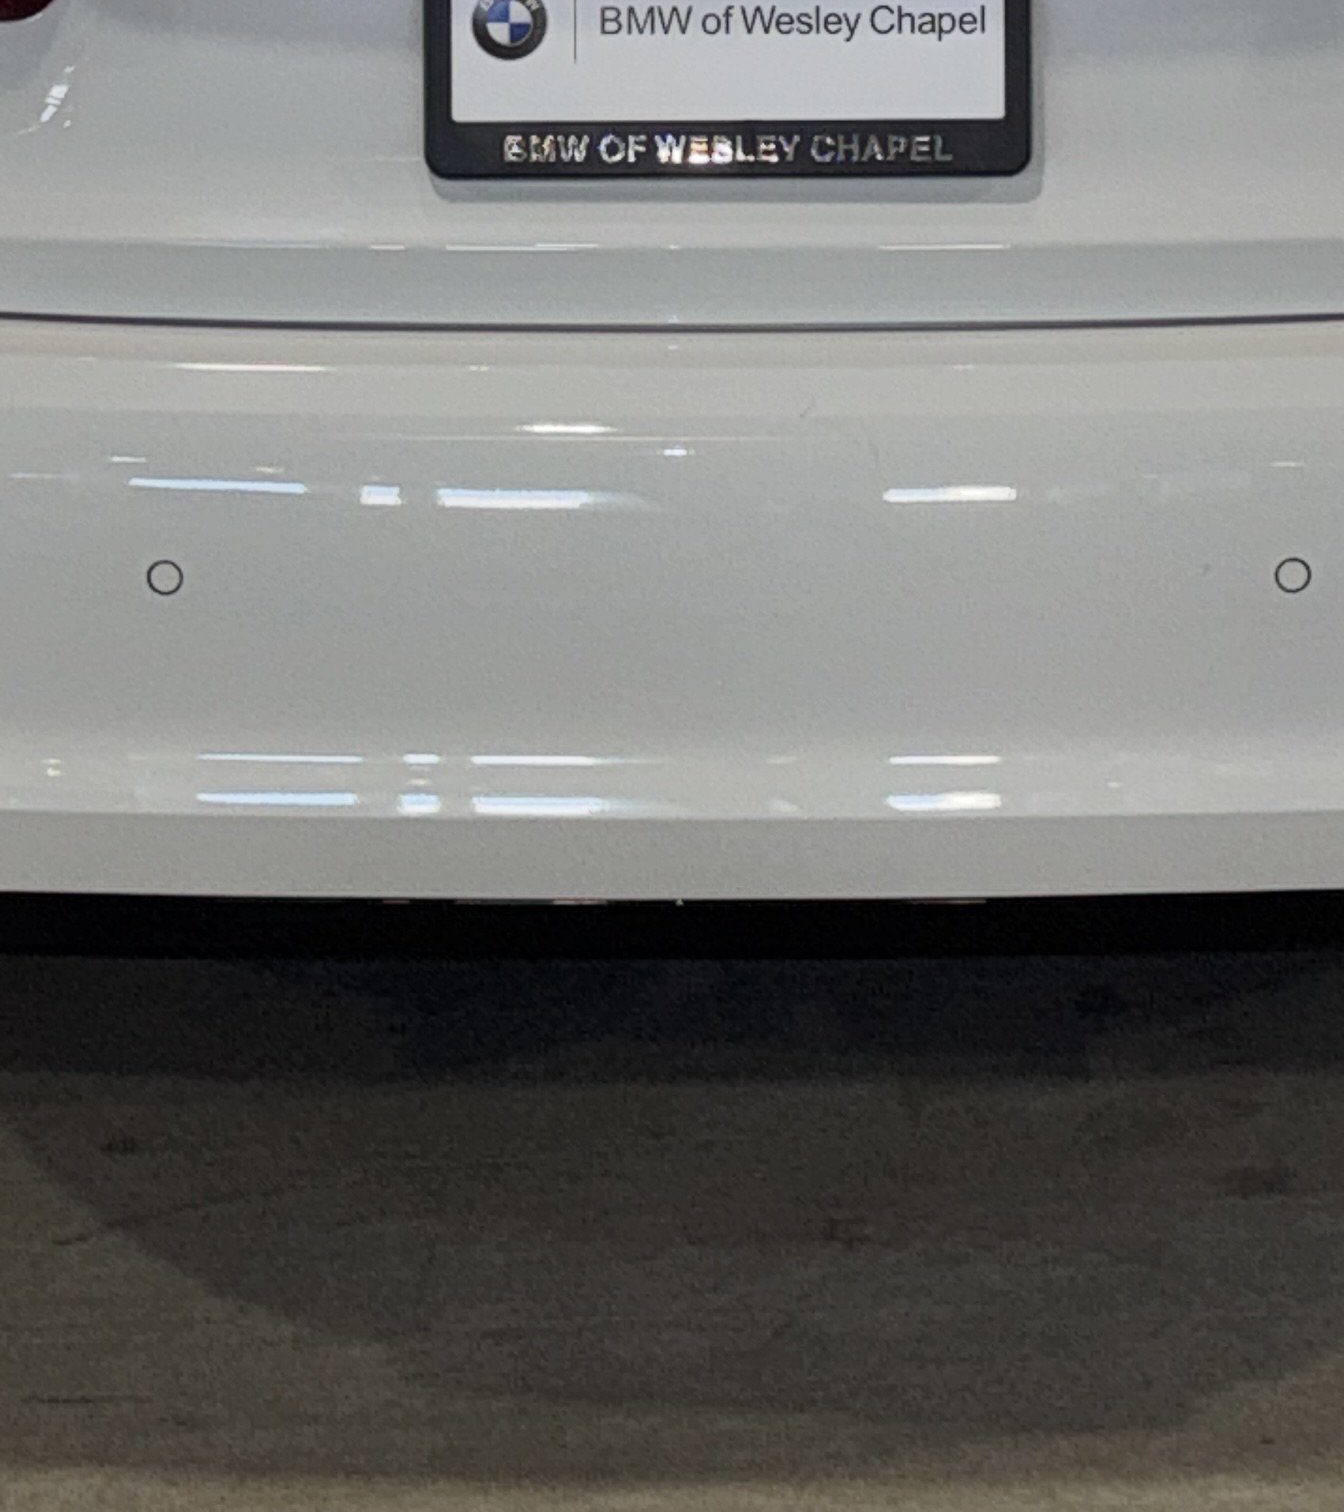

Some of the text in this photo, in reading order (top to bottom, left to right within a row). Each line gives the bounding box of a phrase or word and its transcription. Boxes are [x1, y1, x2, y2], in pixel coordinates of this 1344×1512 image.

[599, 4, 986, 43] BMW of Wesley Chapel
[504, 134, 954, 165] BMW OF WESLEY CHAPEL
